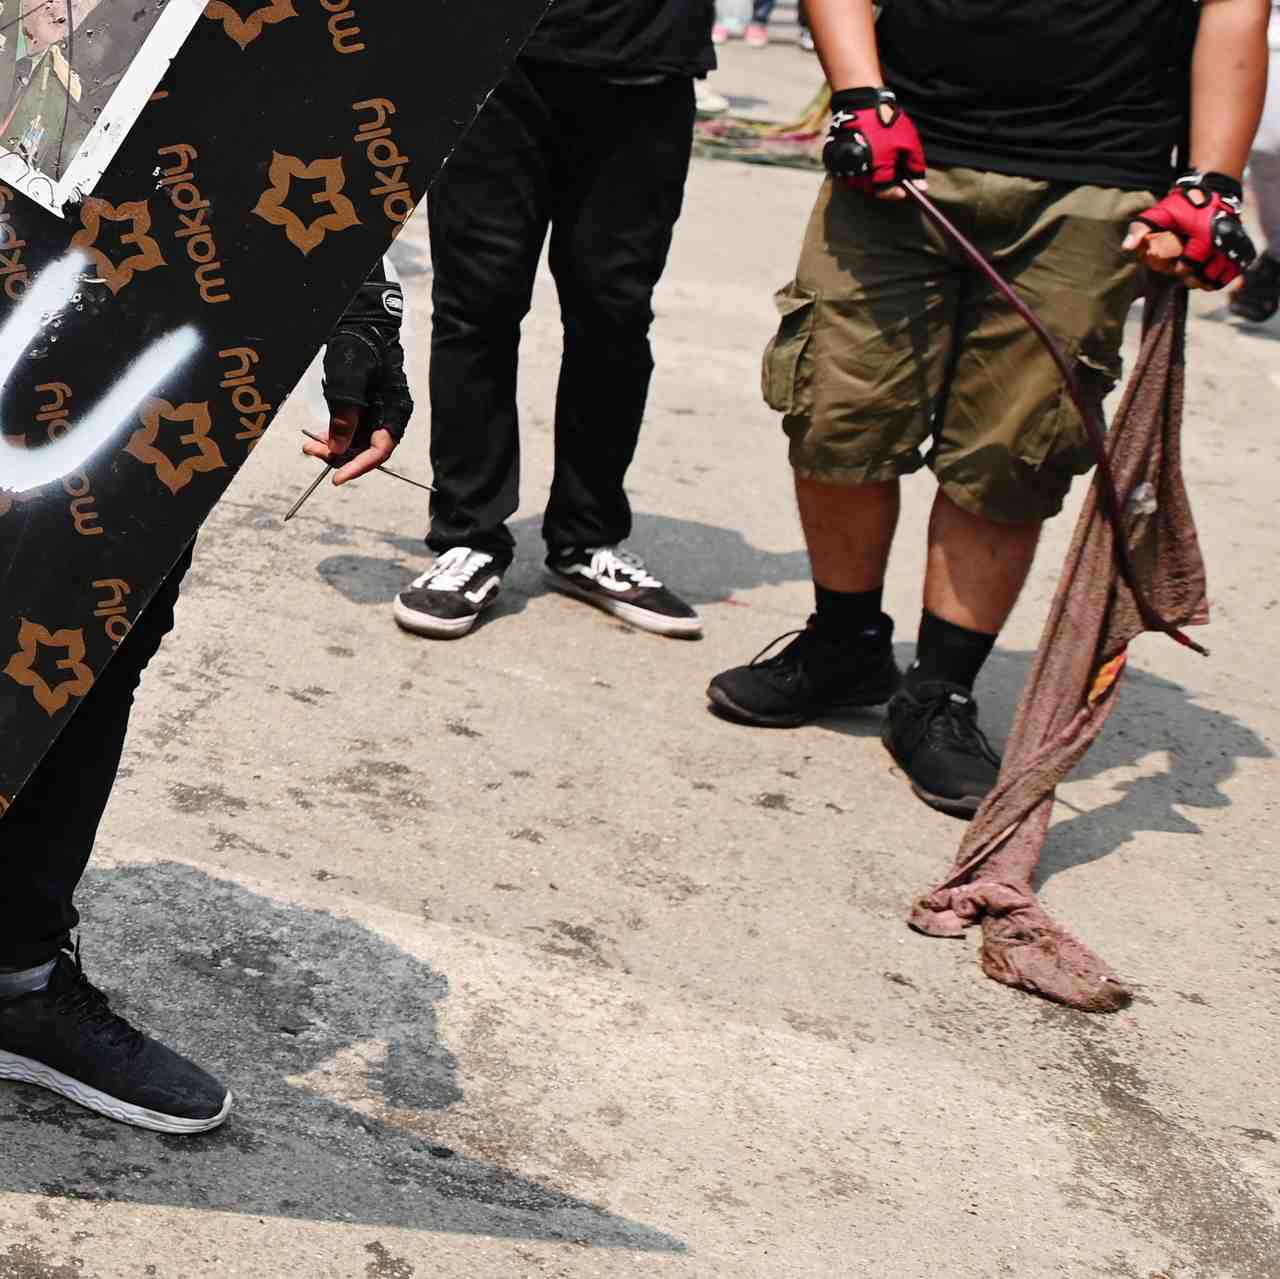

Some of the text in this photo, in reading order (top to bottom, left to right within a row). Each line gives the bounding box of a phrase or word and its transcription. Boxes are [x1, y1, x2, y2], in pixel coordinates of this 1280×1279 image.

[158, 143, 230, 303] makply
[36, 382, 103, 537] maly
[220, 346, 273, 451] kply
[92, 577, 133, 652] ply
